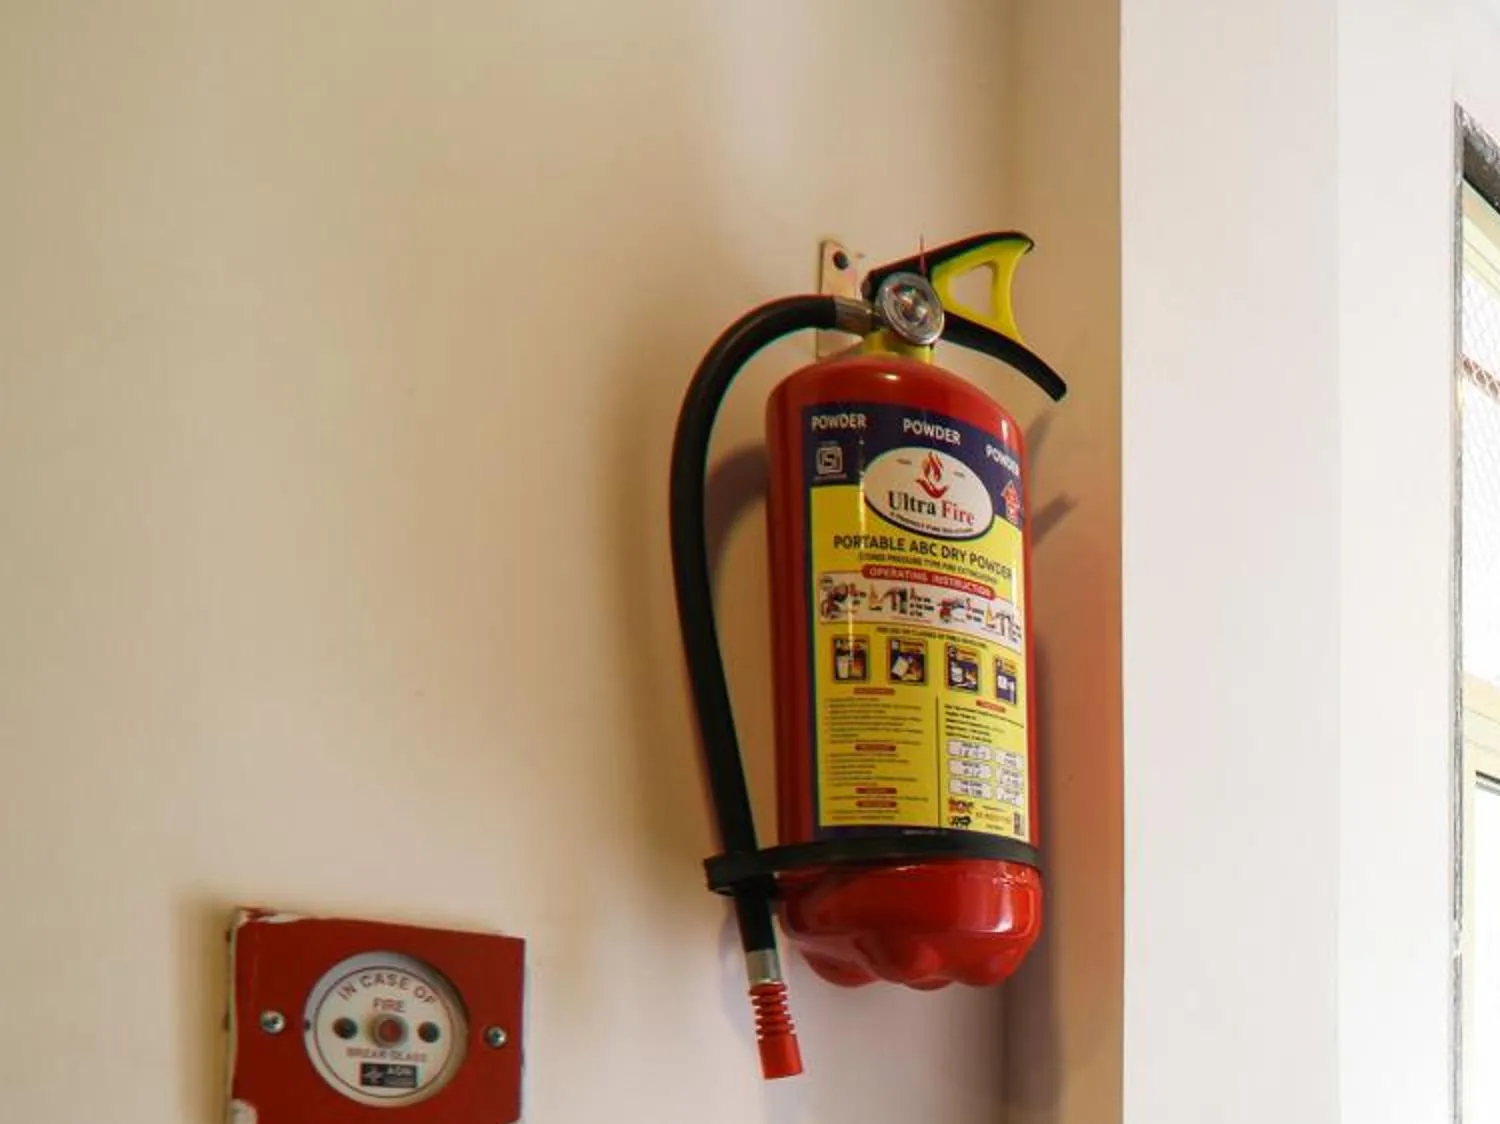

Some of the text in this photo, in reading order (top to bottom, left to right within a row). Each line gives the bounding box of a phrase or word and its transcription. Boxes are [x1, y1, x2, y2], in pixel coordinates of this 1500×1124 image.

[811, 412, 867, 431] POWDER
[903, 417, 961, 445] POWDER
[888, 488, 936, 516] Ultra
[941, 499, 975, 526] Fire
[832, 535, 1012, 578] PORTABLE ABC DRY POWDER
[868, 566, 928, 583] OPERATING
[338, 972, 435, 1005] IN CASE OF
[373, 997, 406, 1013] FIRE
